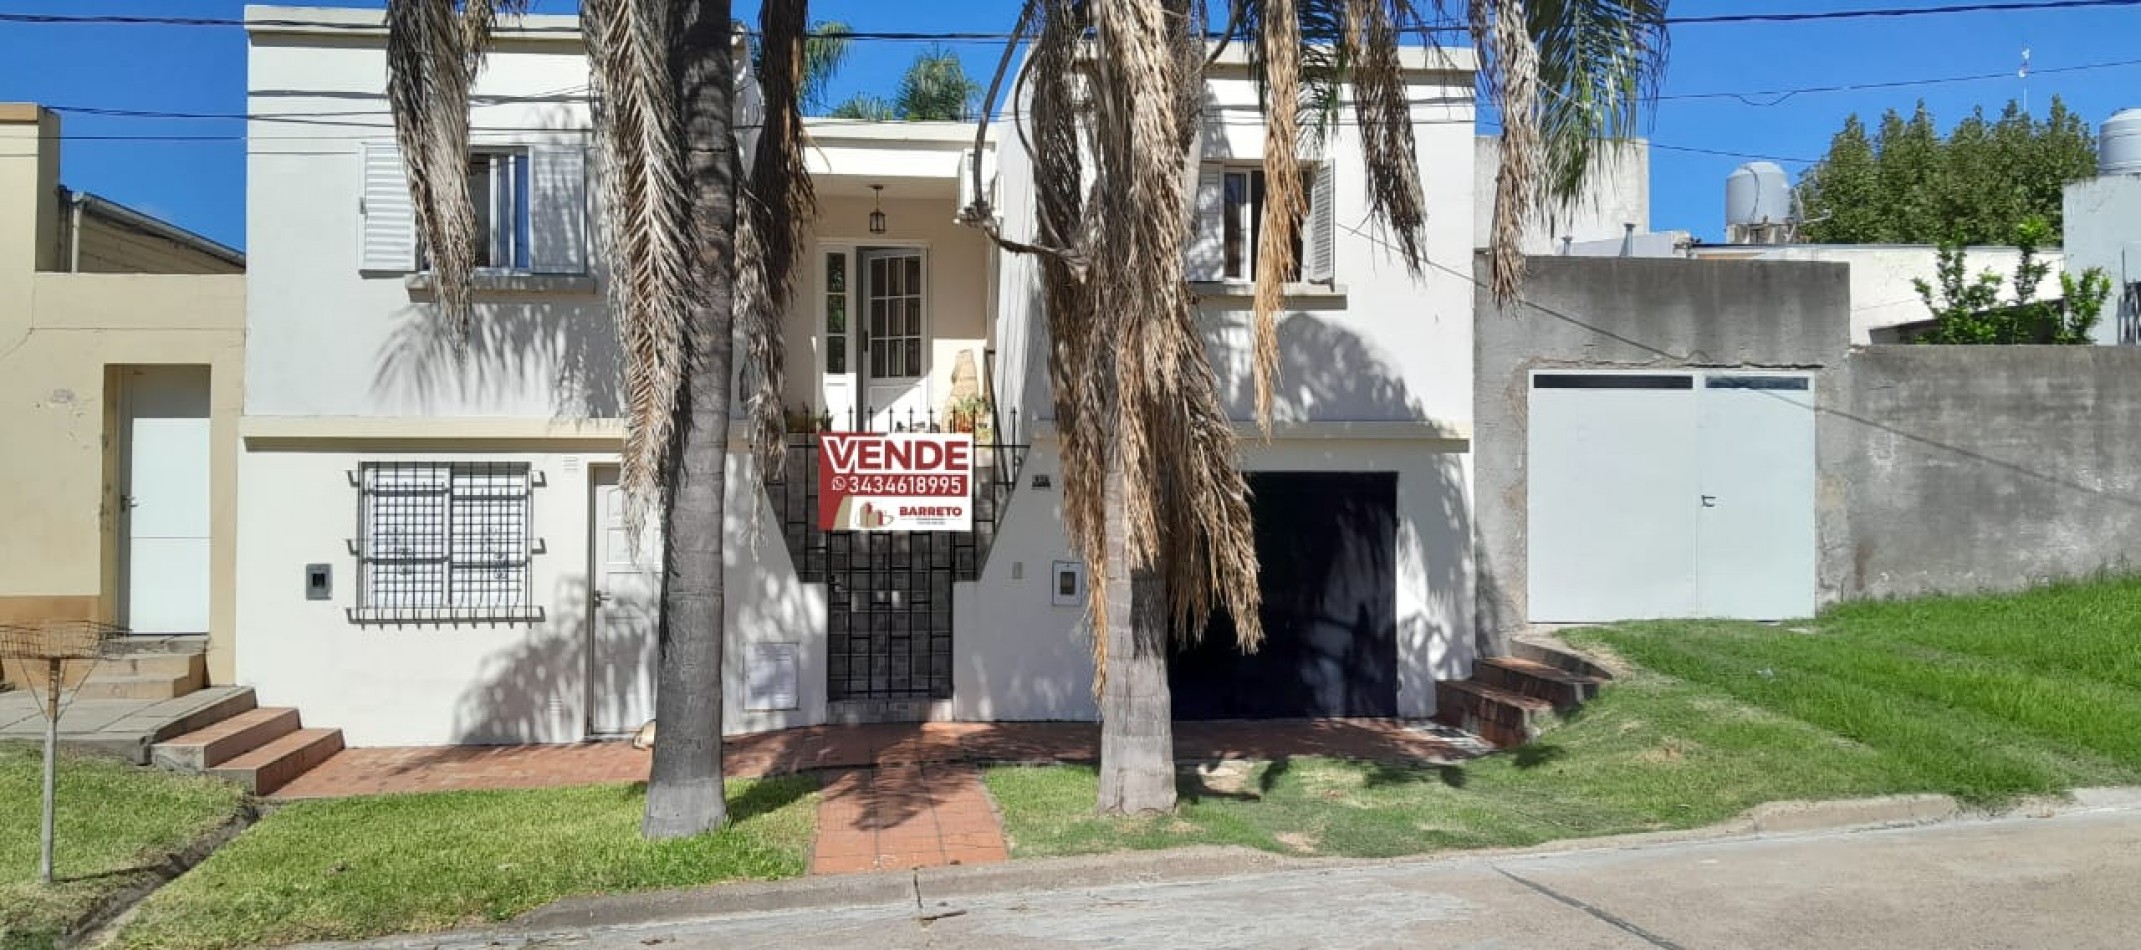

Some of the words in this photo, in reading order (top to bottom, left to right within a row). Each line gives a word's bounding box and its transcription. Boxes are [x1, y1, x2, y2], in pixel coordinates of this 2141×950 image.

[826, 439, 969, 470] VENDE
[848, 476, 961, 494] 3434618995
[899, 506, 963, 516] BARRETO
